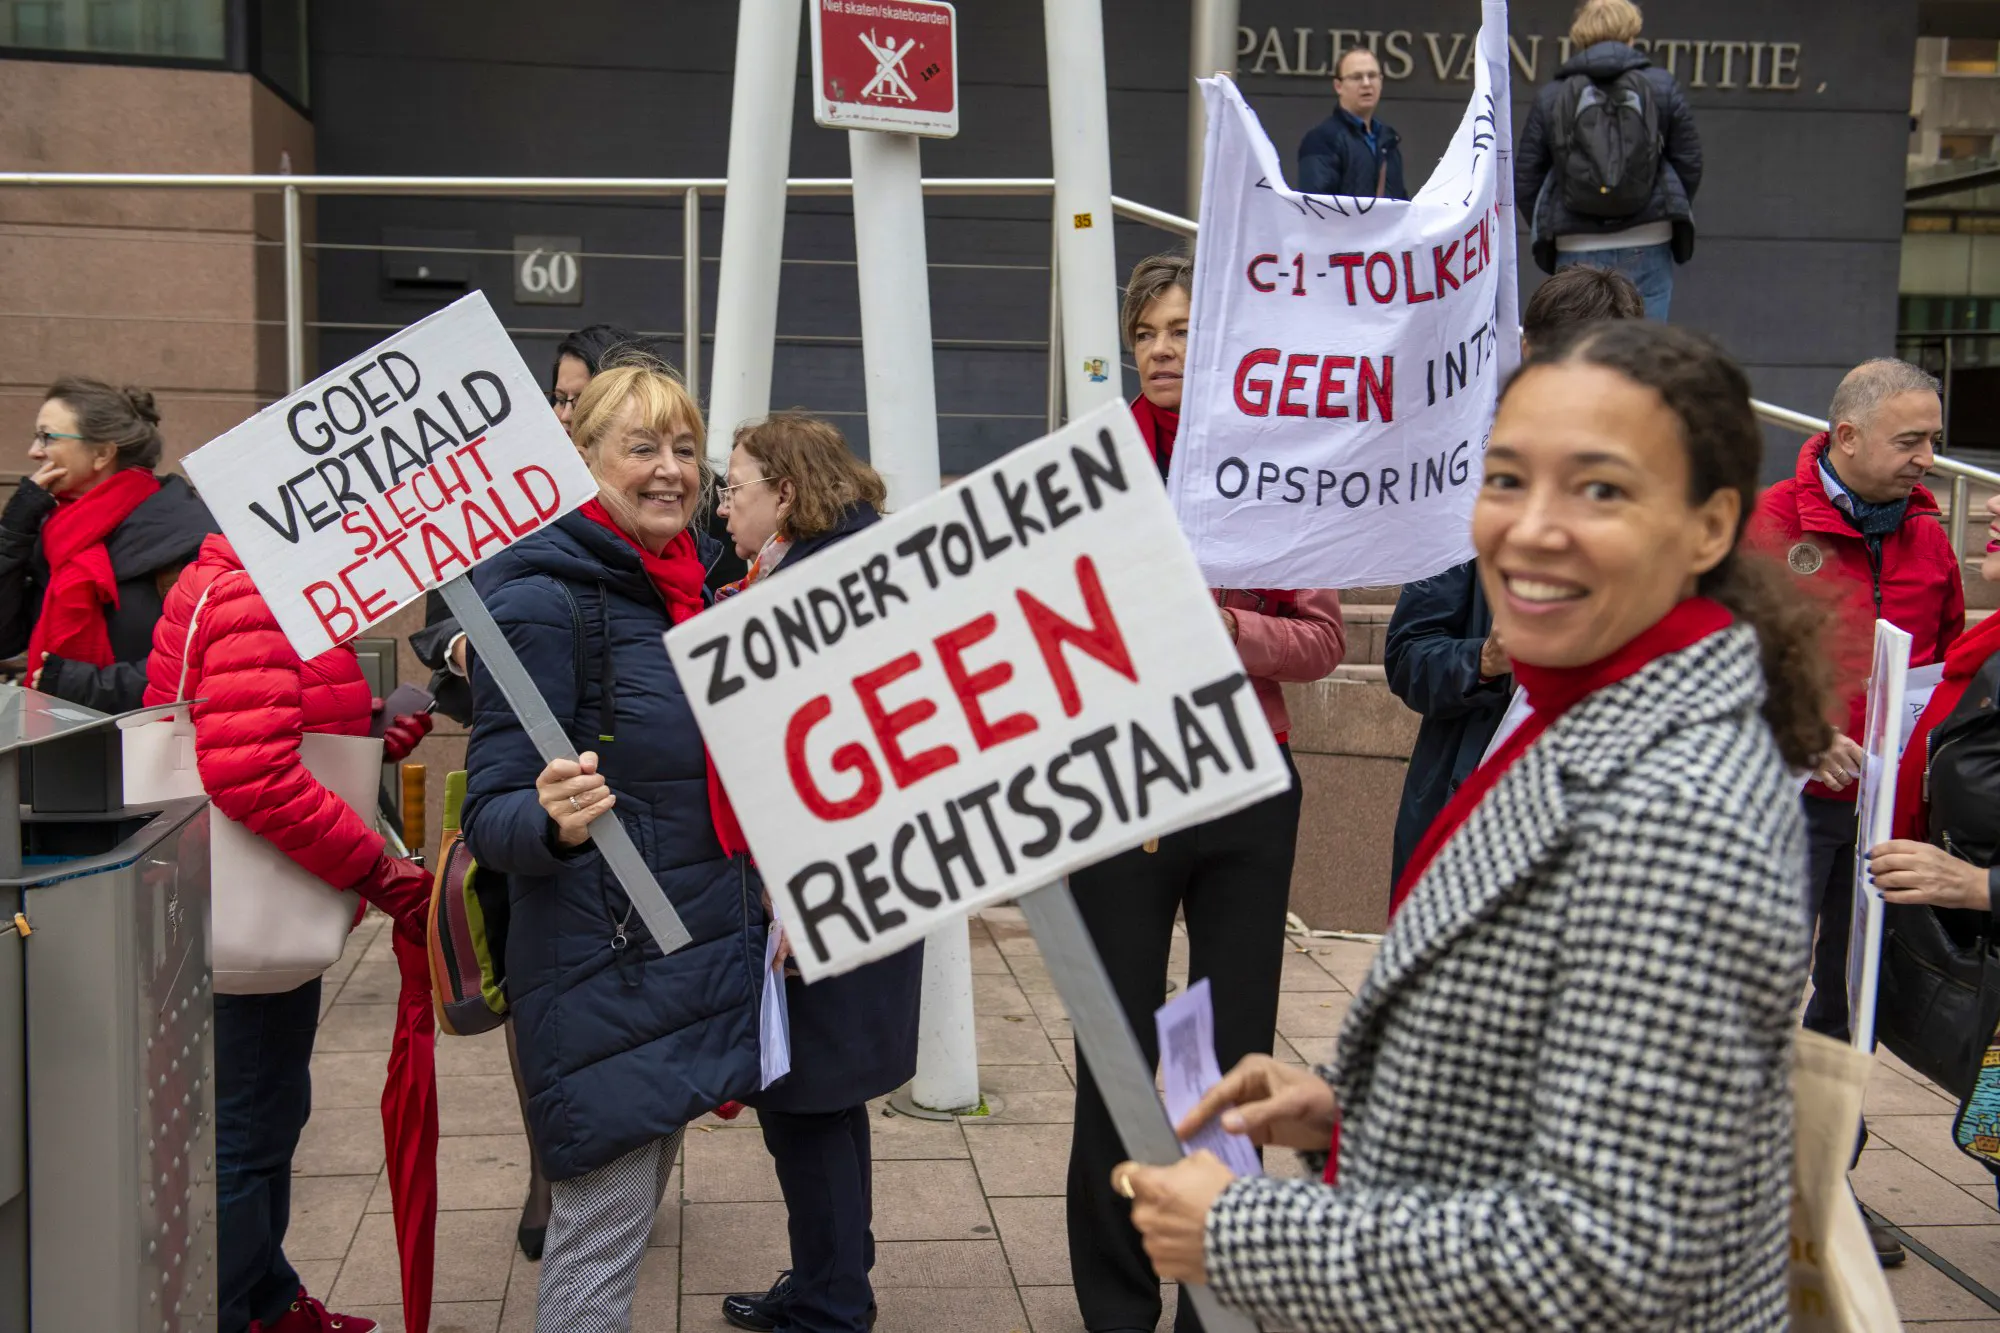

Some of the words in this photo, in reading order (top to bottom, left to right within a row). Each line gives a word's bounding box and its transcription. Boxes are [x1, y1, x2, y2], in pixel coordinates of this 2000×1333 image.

[845, 2, 949, 25] skaten/skateboarden
[1558, 36, 1801, 89] JTITIE
[521, 248, 577, 293] 60
[1074, 214, 1092, 229] 35
[286, 350, 420, 455] GOED
[1233, 348, 1394, 423] GEEN
[248, 370, 512, 544] VERTAALD
[342, 436, 493, 556] SLECHT
[1216, 440, 1469, 508] OPSPORING
[302, 464, 561, 645] BETAALD
[688, 552, 910, 705] ZONDER
[896, 426, 1128, 590] TOLKEN
[784, 553, 1140, 822] GEEN
[786, 672, 1256, 964] RECHTSSTAAT
